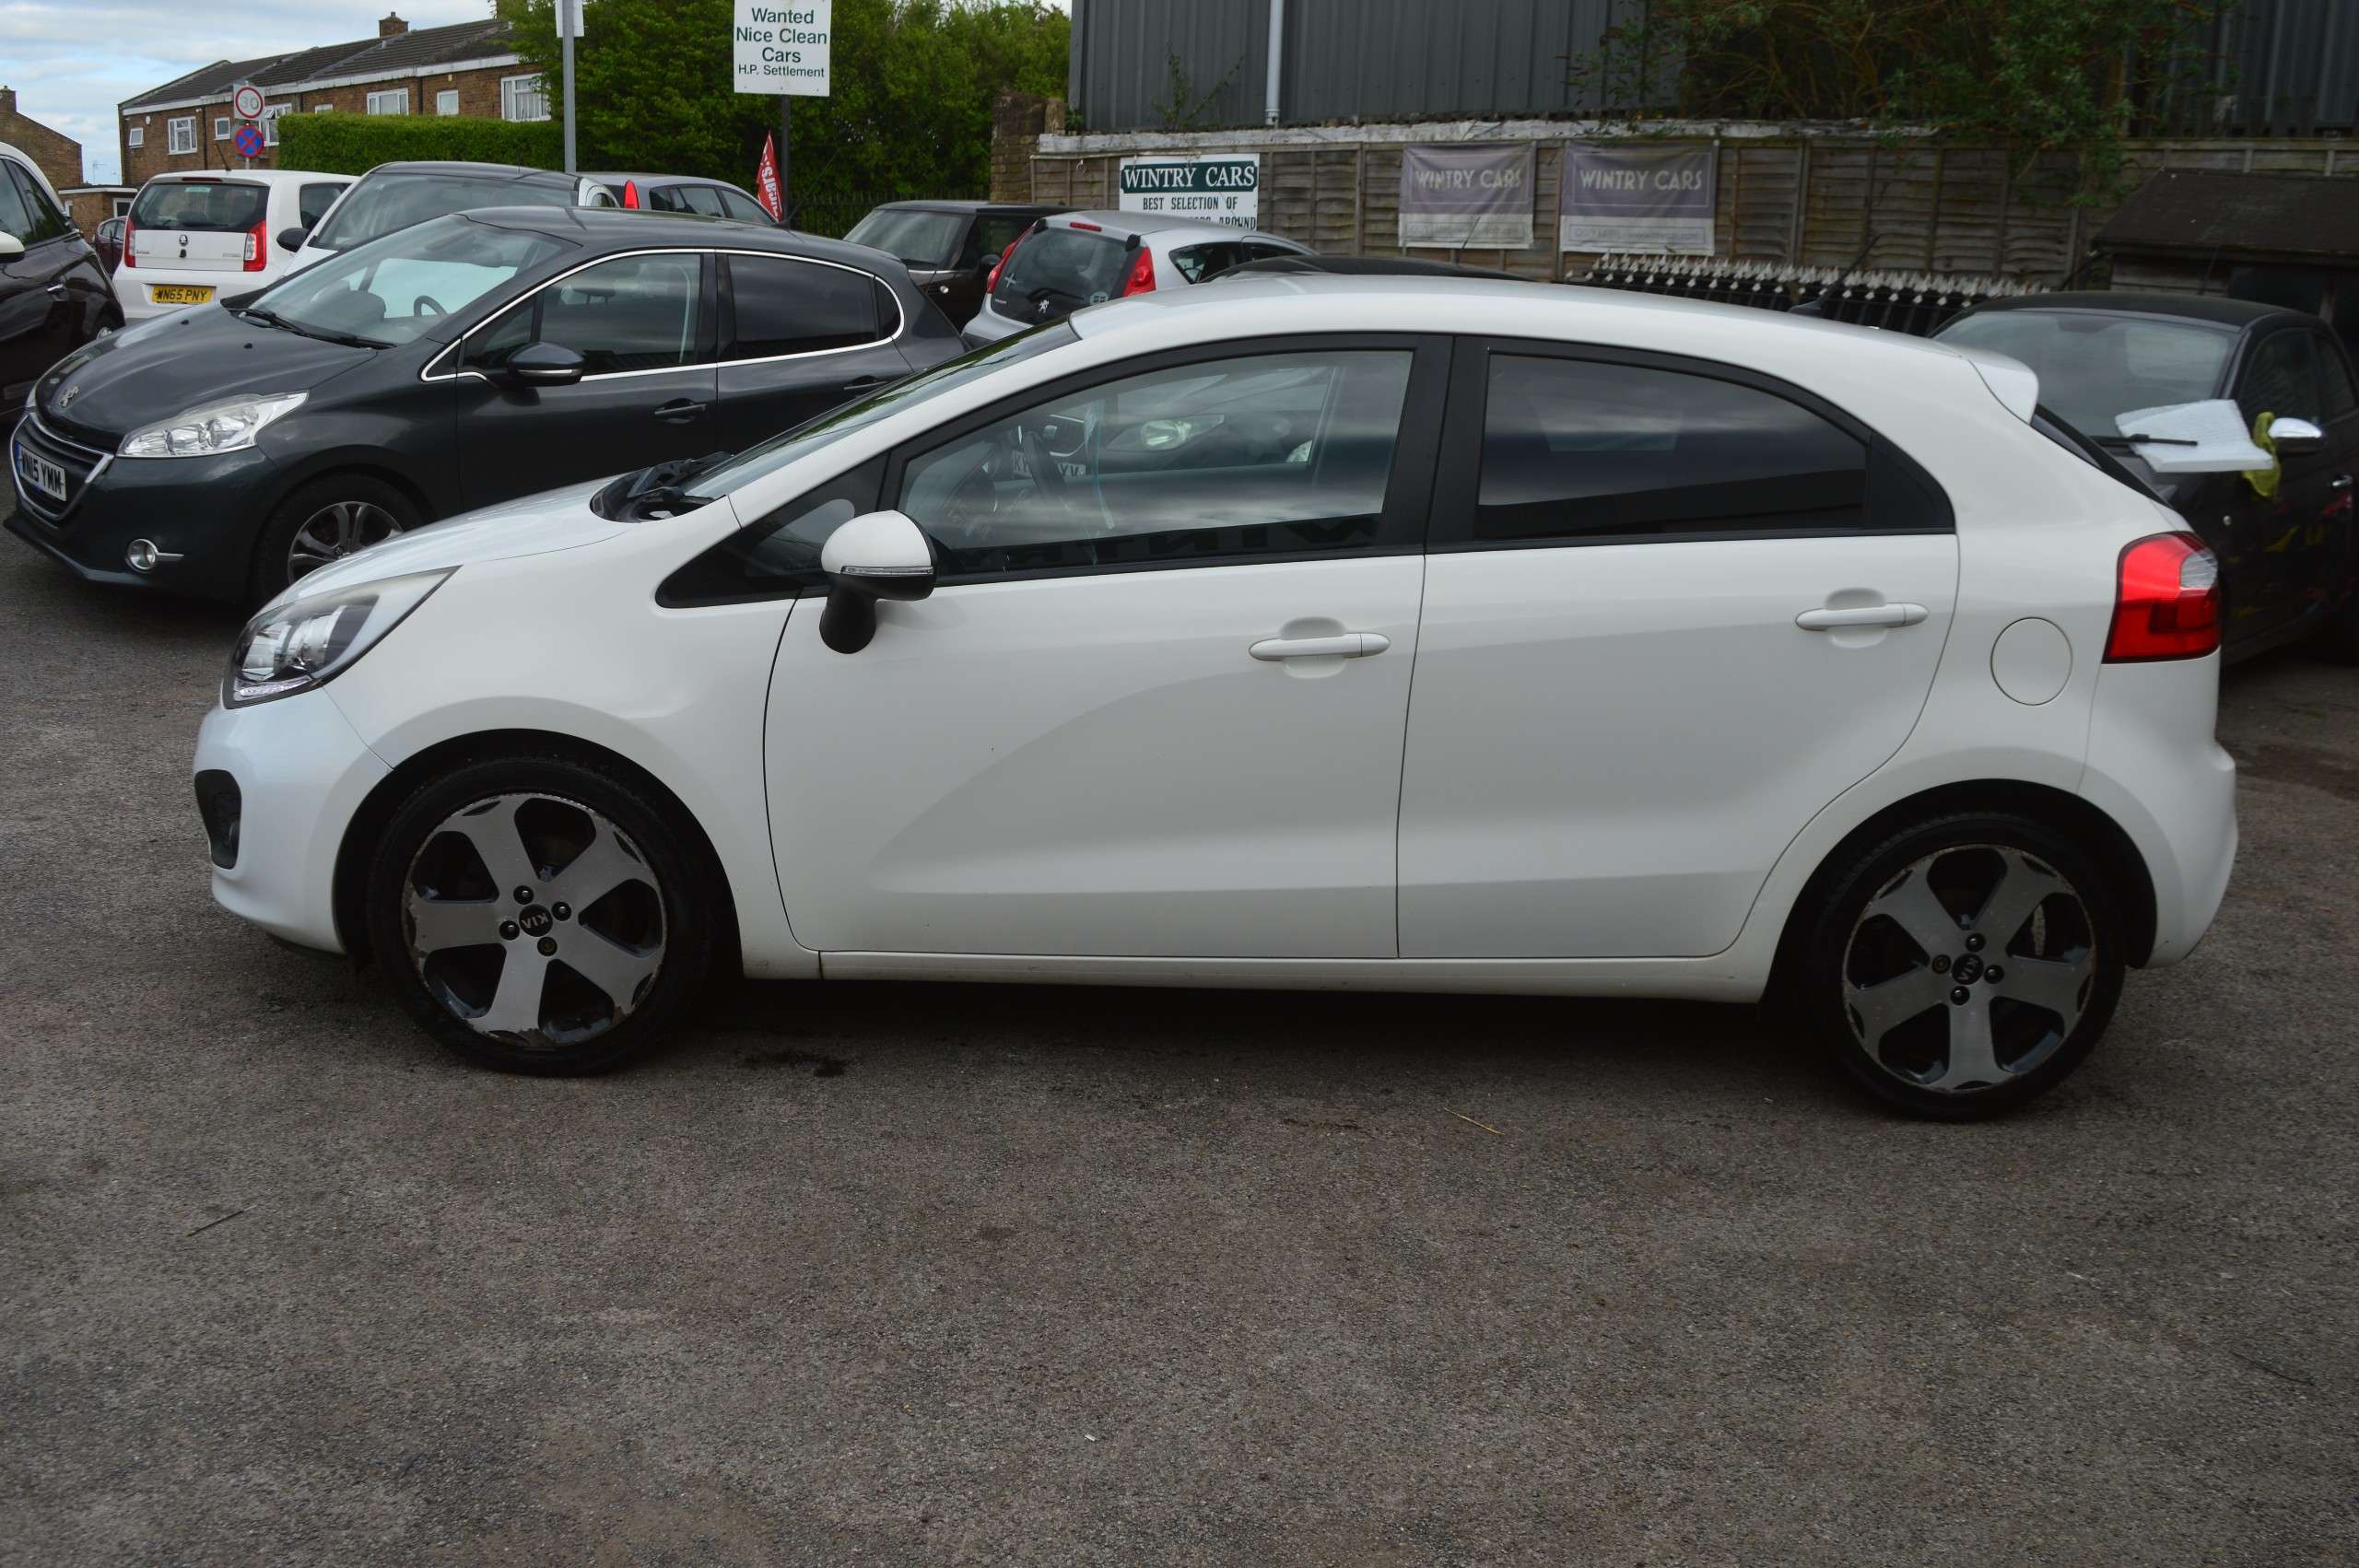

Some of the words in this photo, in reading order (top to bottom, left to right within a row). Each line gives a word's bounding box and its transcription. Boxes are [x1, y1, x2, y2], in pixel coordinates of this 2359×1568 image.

[751, 7, 814, 24] Wanted
[736, 27, 772, 42] Nice
[779, 28, 827, 44] Clean
[761, 46, 802, 63] Cars
[738, 64, 758, 75] H.P.
[763, 64, 825, 77] Settlement
[240, 95, 259, 110] 30
[1124, 167, 1196, 188] WINTRY
[1205, 166, 1254, 187] CARS
[1415, 170, 1474, 189] WINTRY
[1480, 169, 1520, 189] CARS
[1579, 170, 1649, 190] WINTRY
[1655, 170, 1702, 190] CARS
[1143, 196, 1164, 210] BEST
[1171, 196, 1218, 210] SELECTION
[1226, 196, 1238, 209] OF
[157, 288, 182, 299] WN65
[185, 288, 207, 301] PNY
[41, 462, 62, 495] YMM
